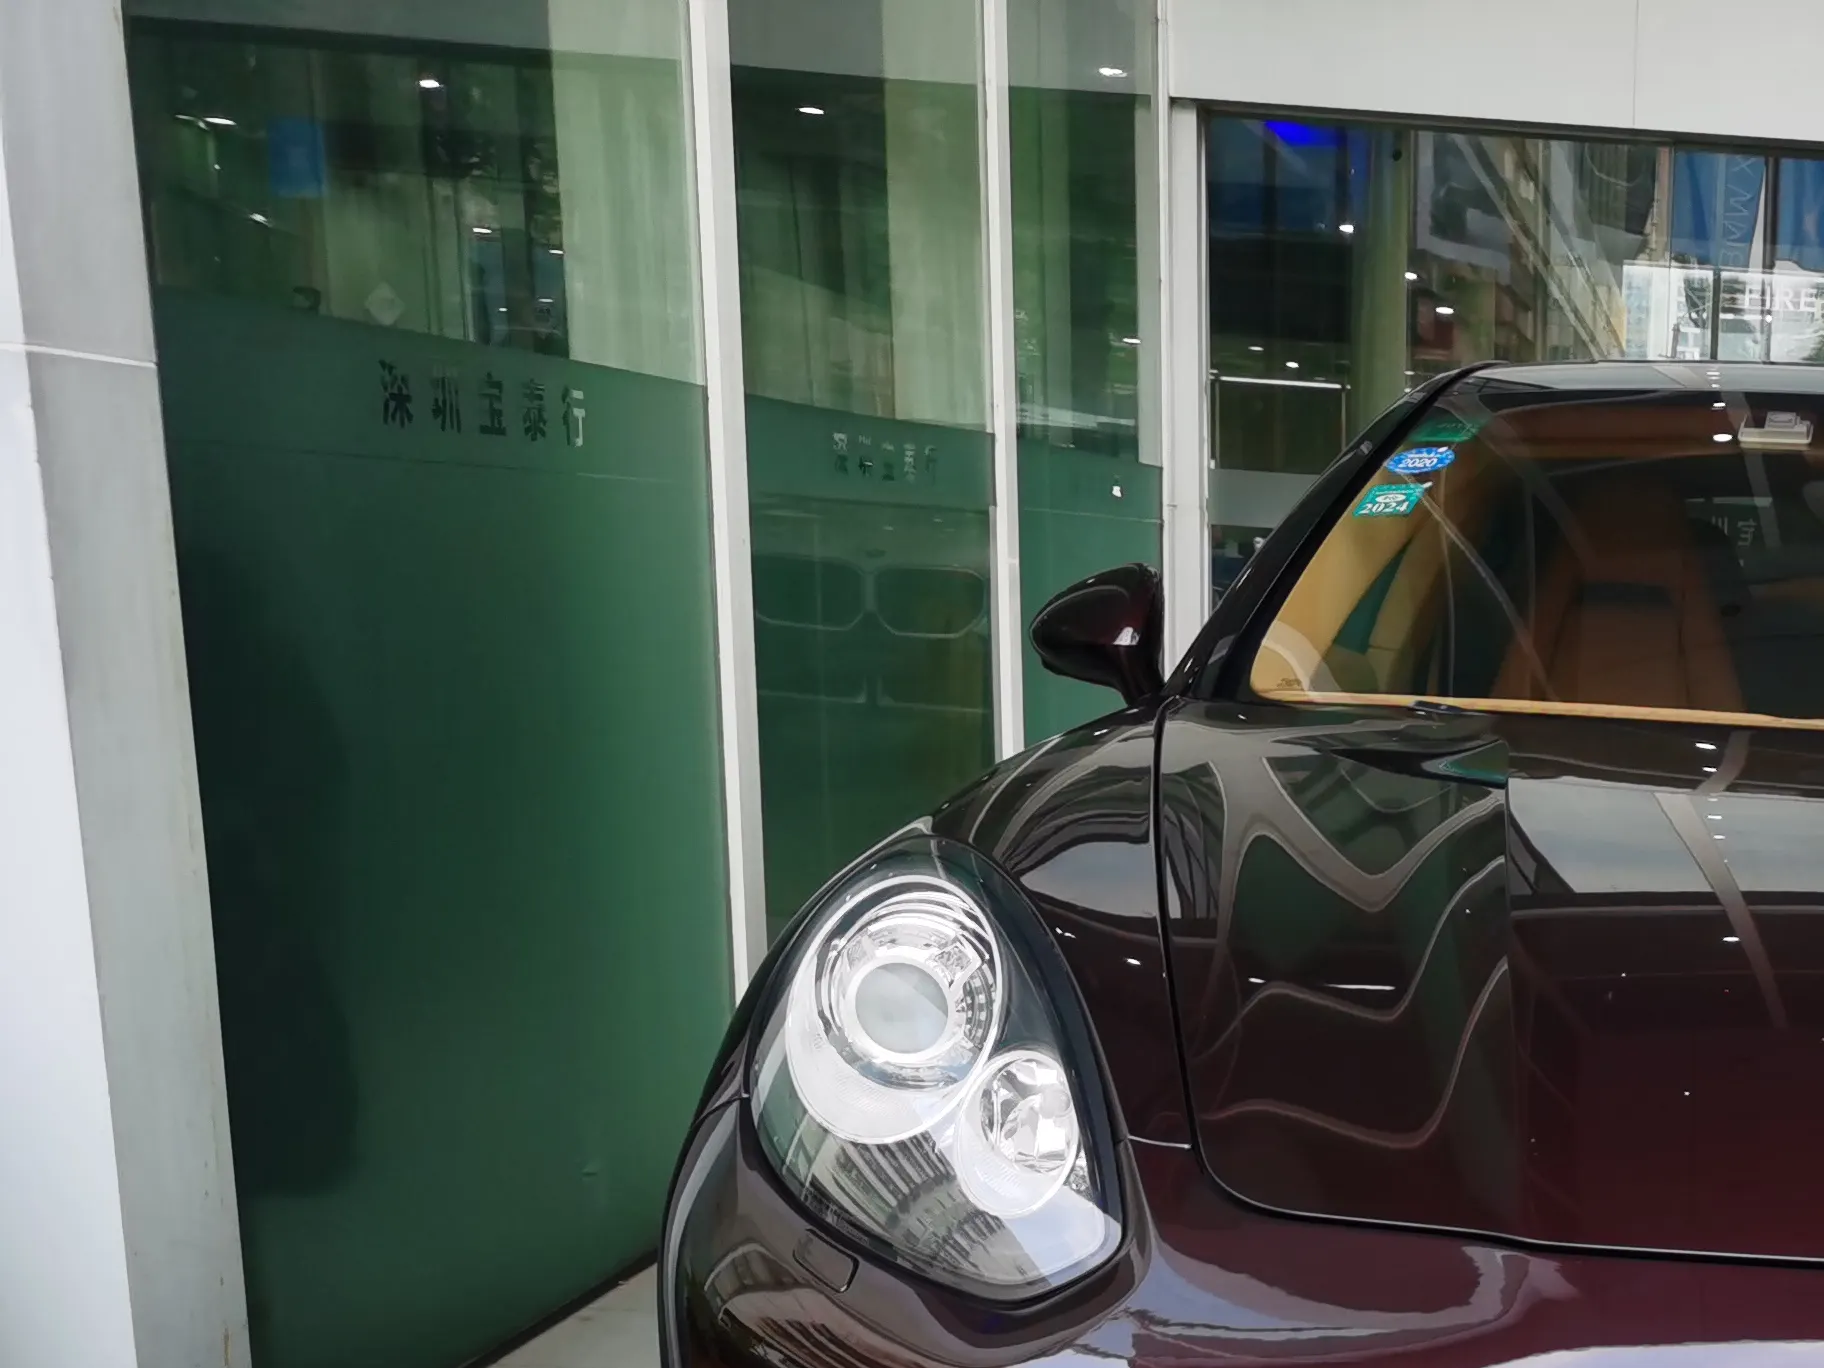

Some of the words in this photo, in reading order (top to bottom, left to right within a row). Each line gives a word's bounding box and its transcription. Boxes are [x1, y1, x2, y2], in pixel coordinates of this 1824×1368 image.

[378, 358, 587, 448] 深圳宝泰行
[1358, 501, 1409, 514] 2024
